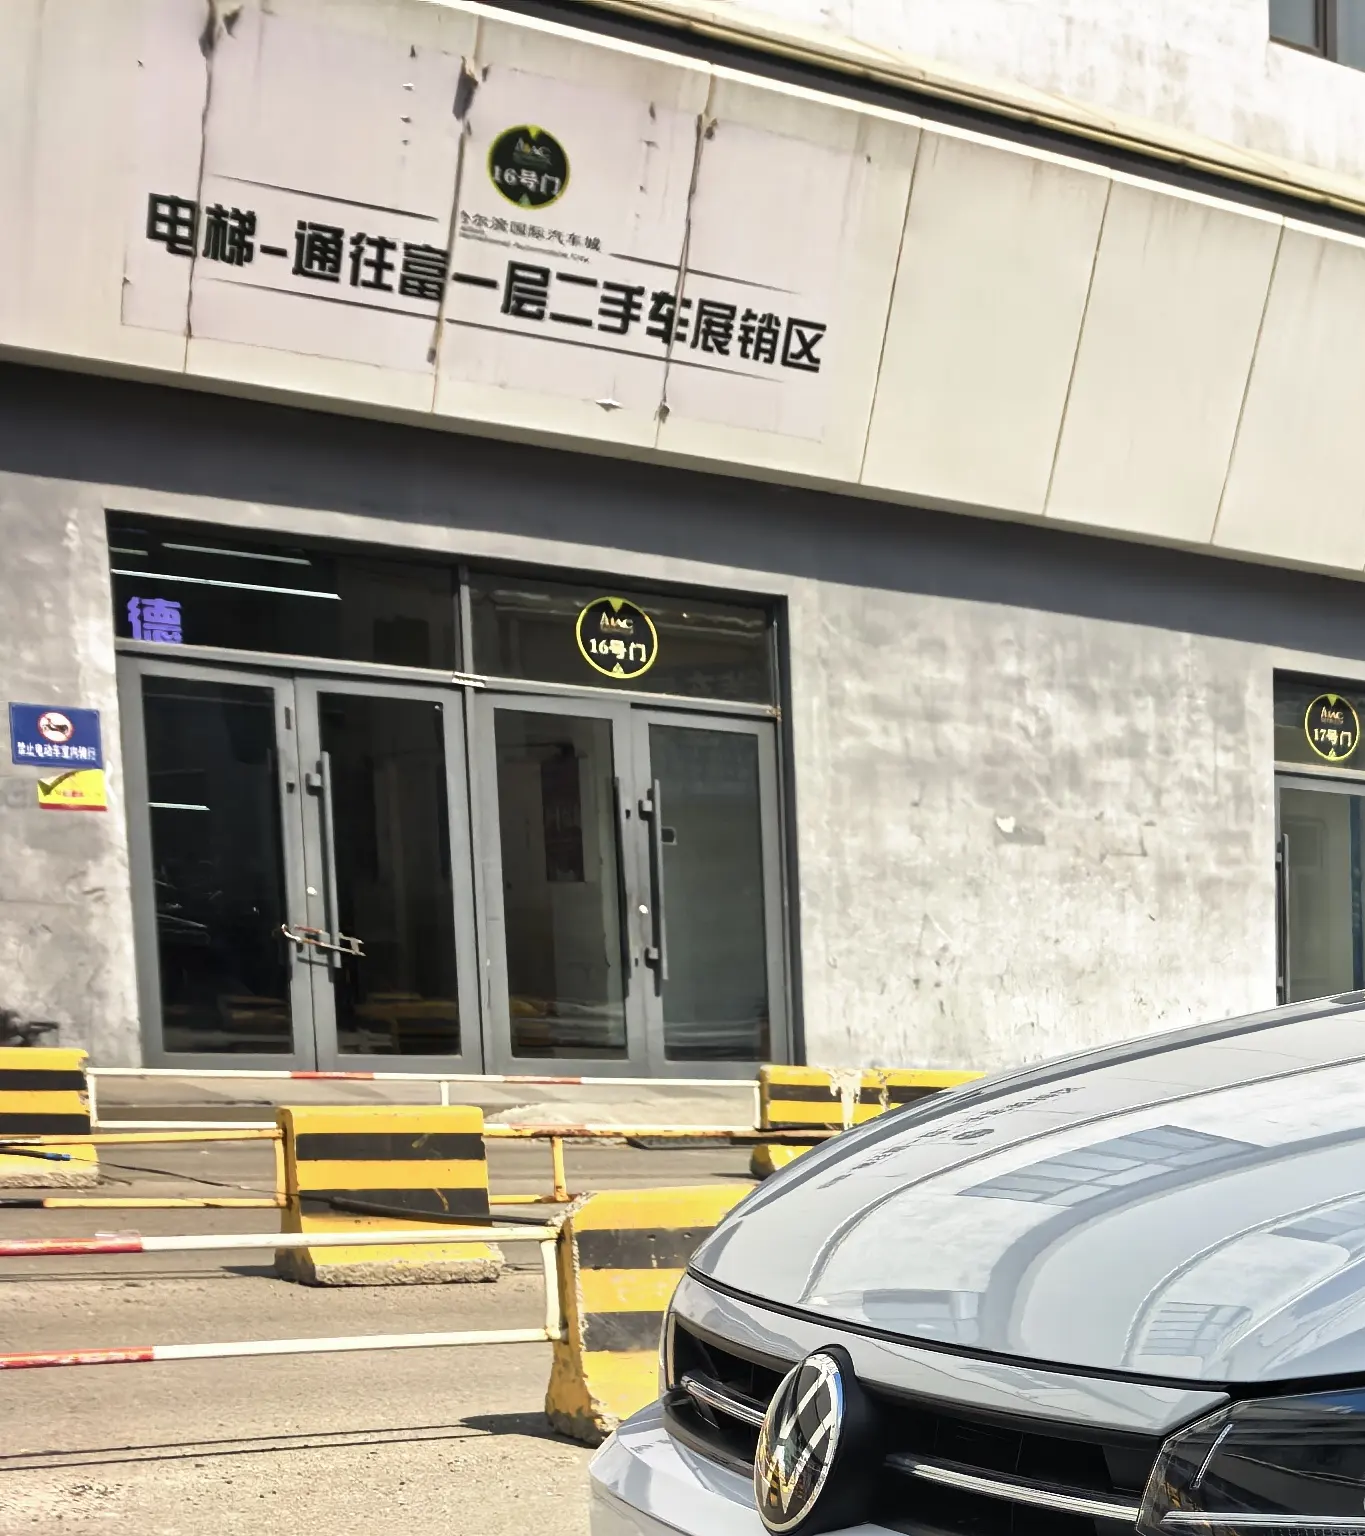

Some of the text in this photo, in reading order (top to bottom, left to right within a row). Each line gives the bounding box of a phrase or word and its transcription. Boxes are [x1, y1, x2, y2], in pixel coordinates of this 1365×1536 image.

[493, 165, 562, 195] 16号门
[127, 596, 182, 644] 德
[589, 638, 647, 663] 16号门
[1313, 728, 1352, 748] 17号门
